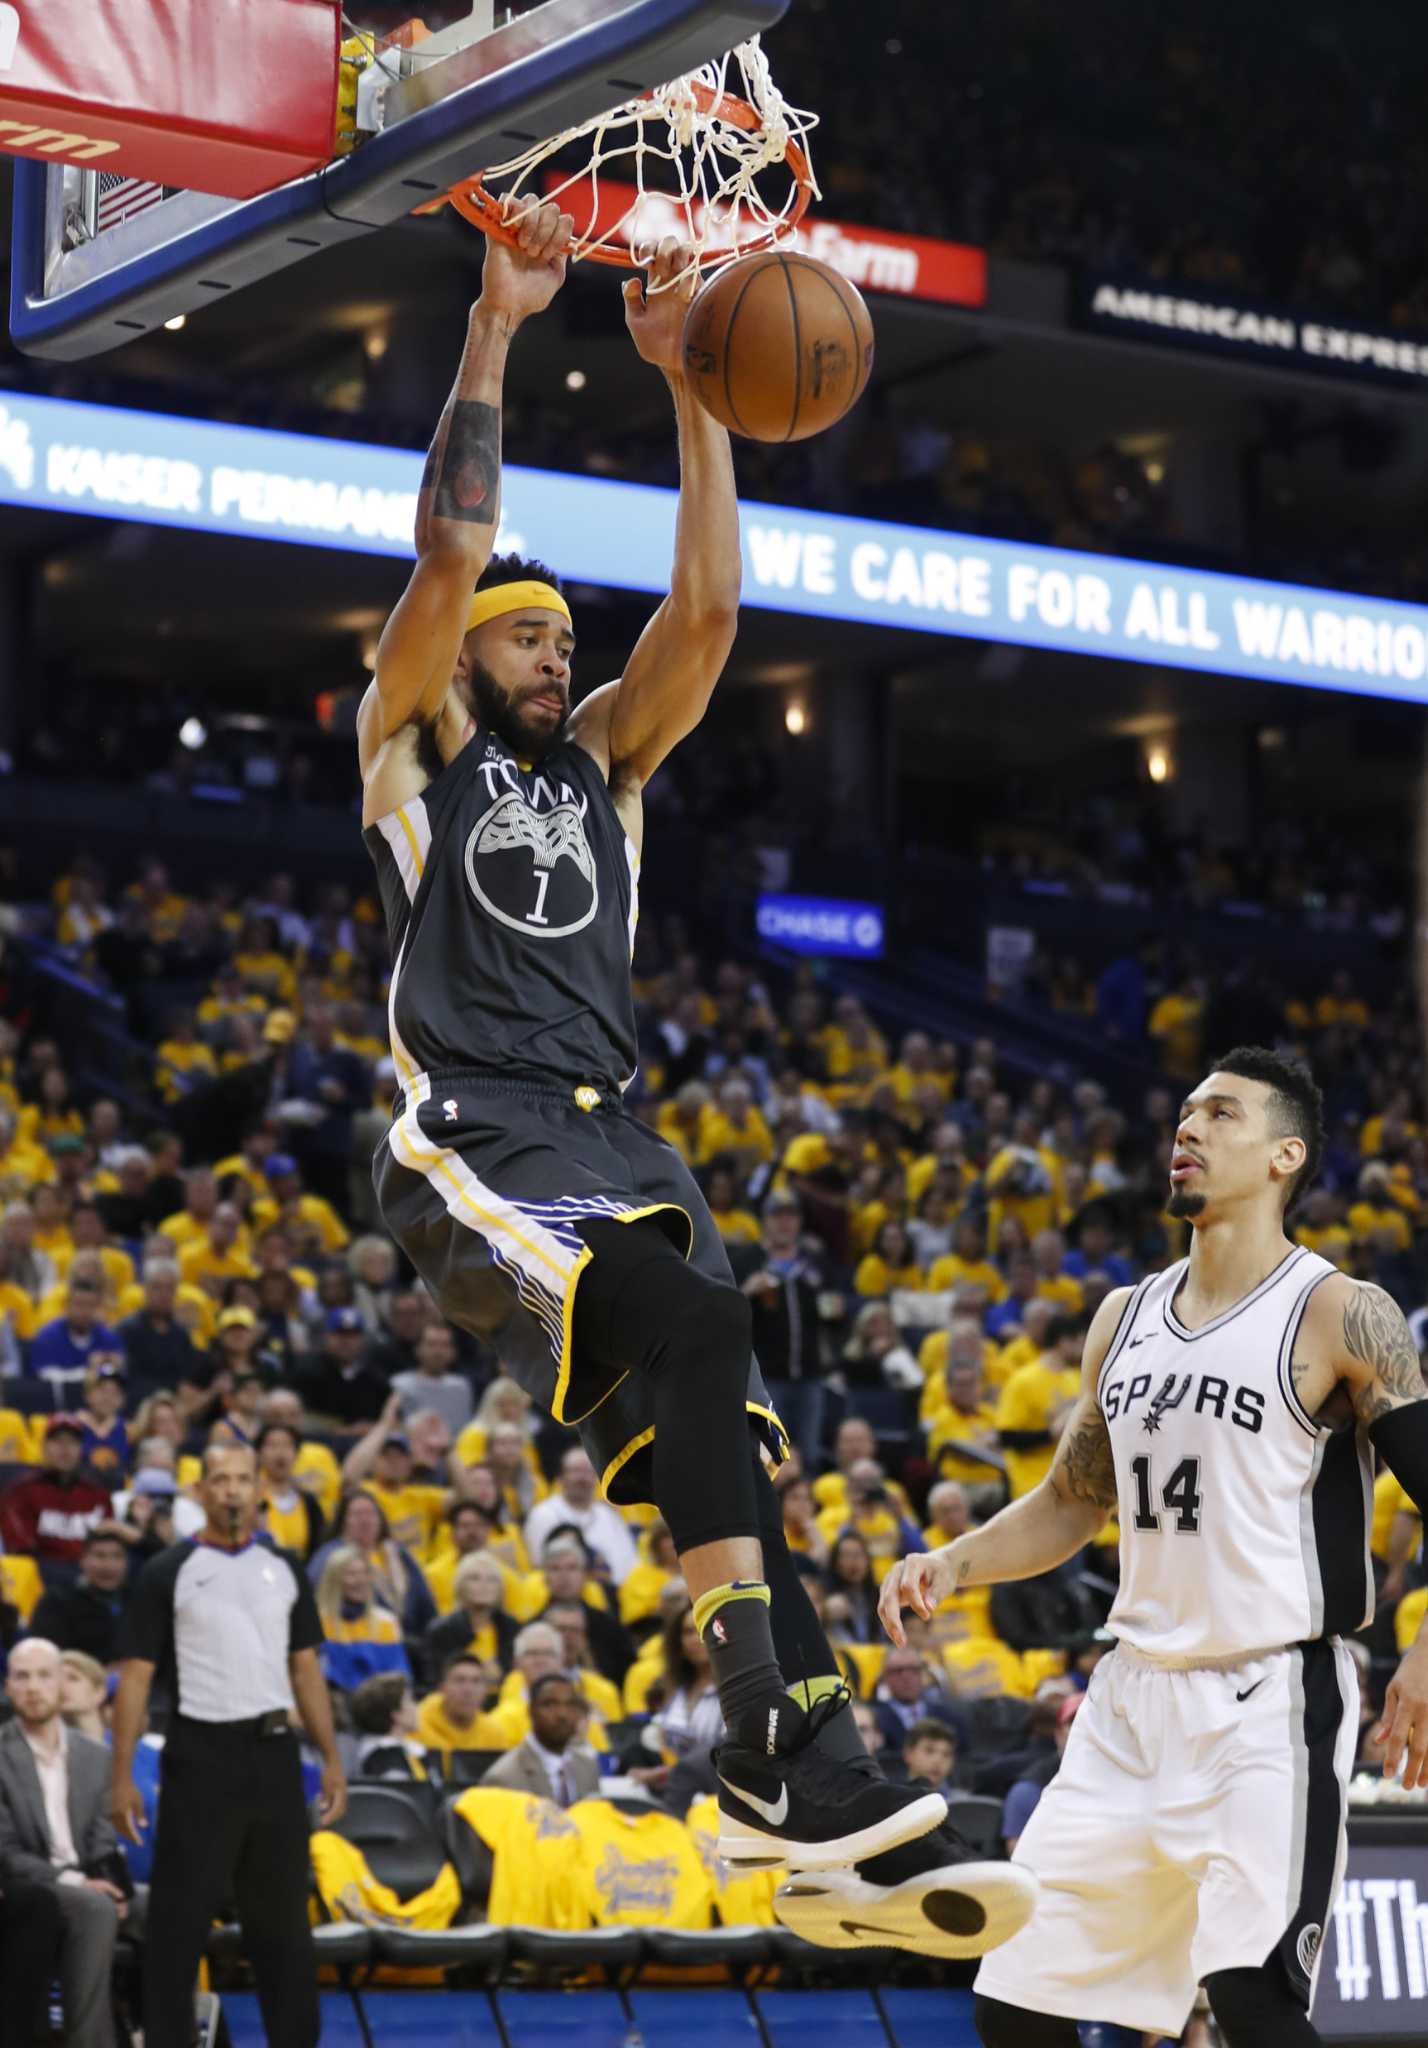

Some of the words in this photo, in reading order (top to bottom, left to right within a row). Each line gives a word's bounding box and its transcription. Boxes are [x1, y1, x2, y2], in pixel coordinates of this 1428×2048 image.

[1093, 285, 1296, 349] AMERICAN
[46, 443, 203, 513] KAISER
[747, 526, 837, 595] WE
[851, 542, 991, 618] CARE
[1008, 563, 1112, 634] FOR
[1124, 582, 1221, 650] ALL
[477, 759, 588, 819] TOWN
[526, 870, 551, 925] 1
[756, 905, 850, 943] CHASE
[1105, 1373, 1265, 1435] SPURS
[1129, 1452, 1203, 1536] 14
